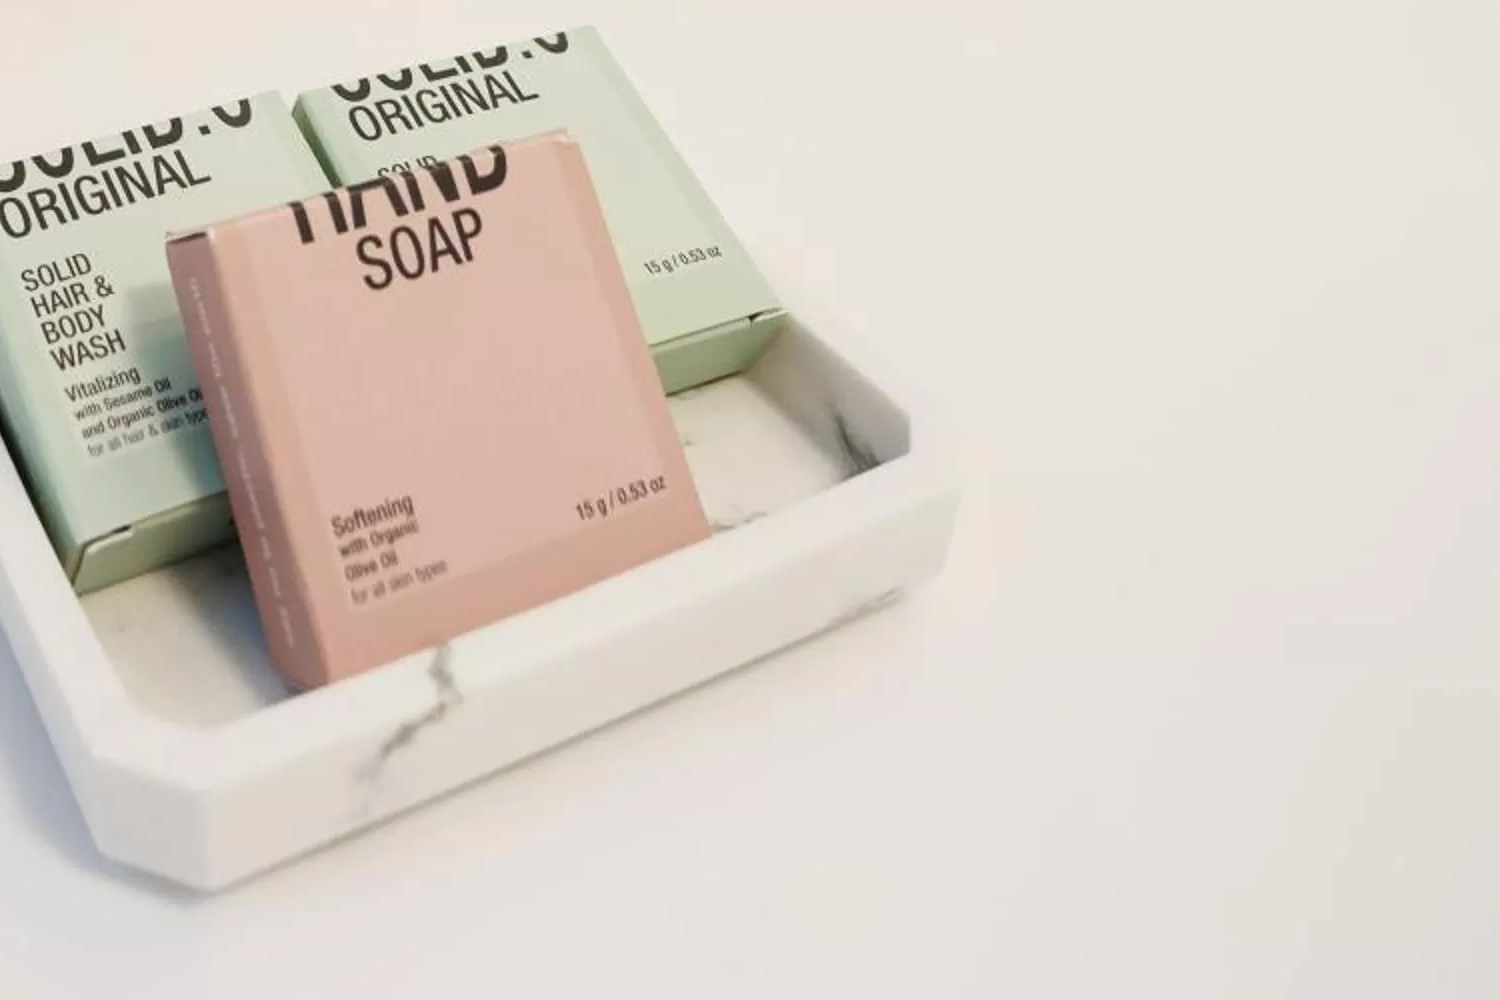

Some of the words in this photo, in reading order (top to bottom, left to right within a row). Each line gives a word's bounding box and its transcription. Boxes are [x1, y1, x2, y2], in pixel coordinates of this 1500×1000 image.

[349, 70, 540, 141] ORIGINAL
[356, 207, 483, 291] SOAP
[644, 260, 662, 276] 15
[21, 253, 91, 292] SOLID
[30, 282, 90, 317] HAIR
[94, 275, 114, 298] &
[40, 304, 105, 345] BODY
[50, 328, 126, 371] WASH
[64, 367, 141, 402] Vitalizing
[75, 402, 102, 421] with
[103, 385, 152, 410] Sesame
[82, 421, 105, 439] and
[107, 405, 155, 428] Organic
[331, 496, 414, 538] Softening
[576, 500, 595, 520] 15
[596, 498, 607, 517] g
[617, 479, 648, 505] 0.53
[649, 475, 668, 494] oz
